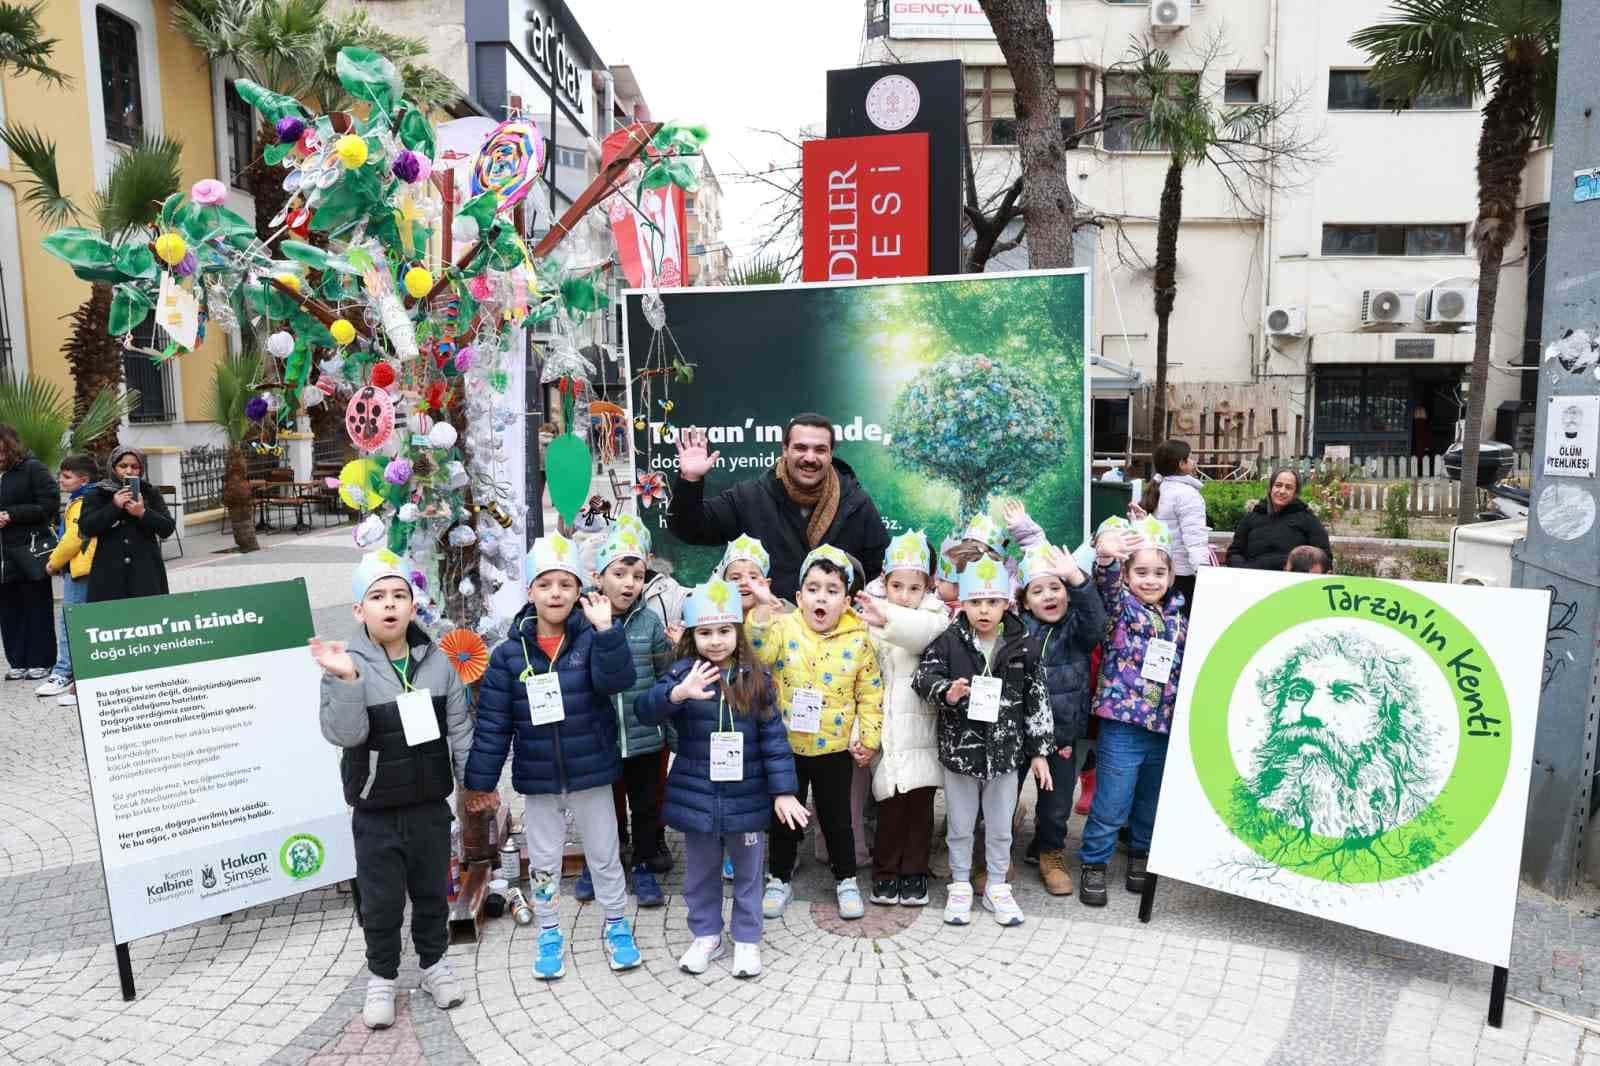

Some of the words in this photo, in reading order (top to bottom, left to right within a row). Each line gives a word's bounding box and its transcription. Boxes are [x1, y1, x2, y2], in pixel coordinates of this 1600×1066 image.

[526, 9, 583, 113] addax
[869, 165, 902, 258] ESİ
[651, 453, 681, 473] doğ
[85, 617, 192, 644] Tarzan'ın
[194, 608, 265, 630] izinde,
[90, 647, 126, 662] doğa
[129, 643, 151, 657] için
[154, 637, 214, 655] yeniden...
[96, 690, 107, 698] Bu
[109, 686, 131, 697] ağaç
[132, 684, 143, 693] bir
[145, 678, 190, 691] semboldür.
[158, 687, 181, 698] değil,
[1447, 648, 1501, 737] Kenti
[98, 704, 130, 718] değerli
[131, 699, 171, 712] olduğunu
[100, 716, 134, 728] Doğaya
[101, 727, 120, 738] yine
[122, 721, 151, 733] birlikte
[118, 831, 134, 841] Her
[136, 825, 163, 838] parça,
[164, 818, 197, 831] doğaya
[198, 809, 229, 822] verilmiş
[229, 805, 241, 815] bir
[119, 842, 132, 850] Ve
[133, 838, 145, 847] bu
[146, 834, 170, 845] ağaç,
[178, 822, 210, 836] sözlerin
[221, 851, 268, 871] Hakan
[164, 867, 193, 881] Kentin
[224, 863, 270, 887] Şimşek
[147, 877, 194, 897] Kalbine
